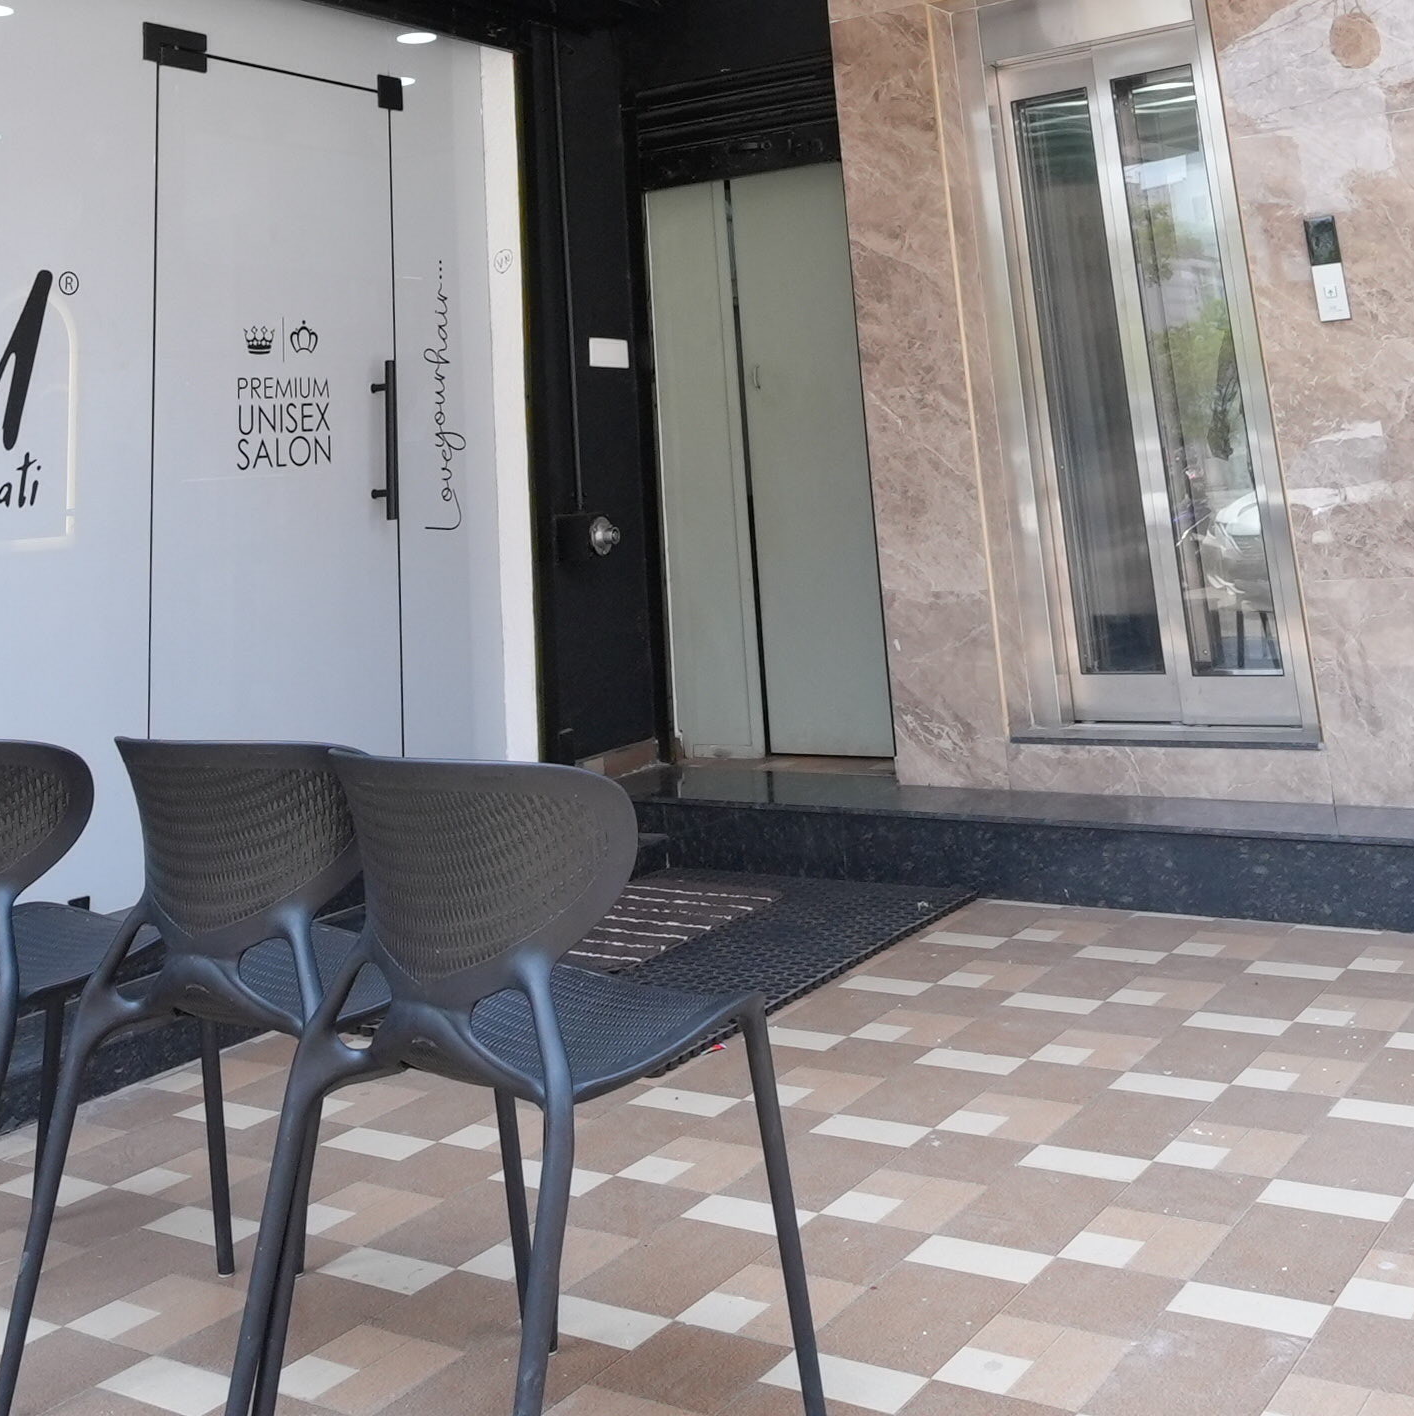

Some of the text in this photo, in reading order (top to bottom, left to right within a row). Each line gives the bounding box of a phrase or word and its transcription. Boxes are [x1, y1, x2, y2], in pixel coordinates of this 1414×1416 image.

[237, 376, 330, 400] PREMIUM
[237, 402, 331, 435] UNISEX
[236, 435, 332, 471] SALON
